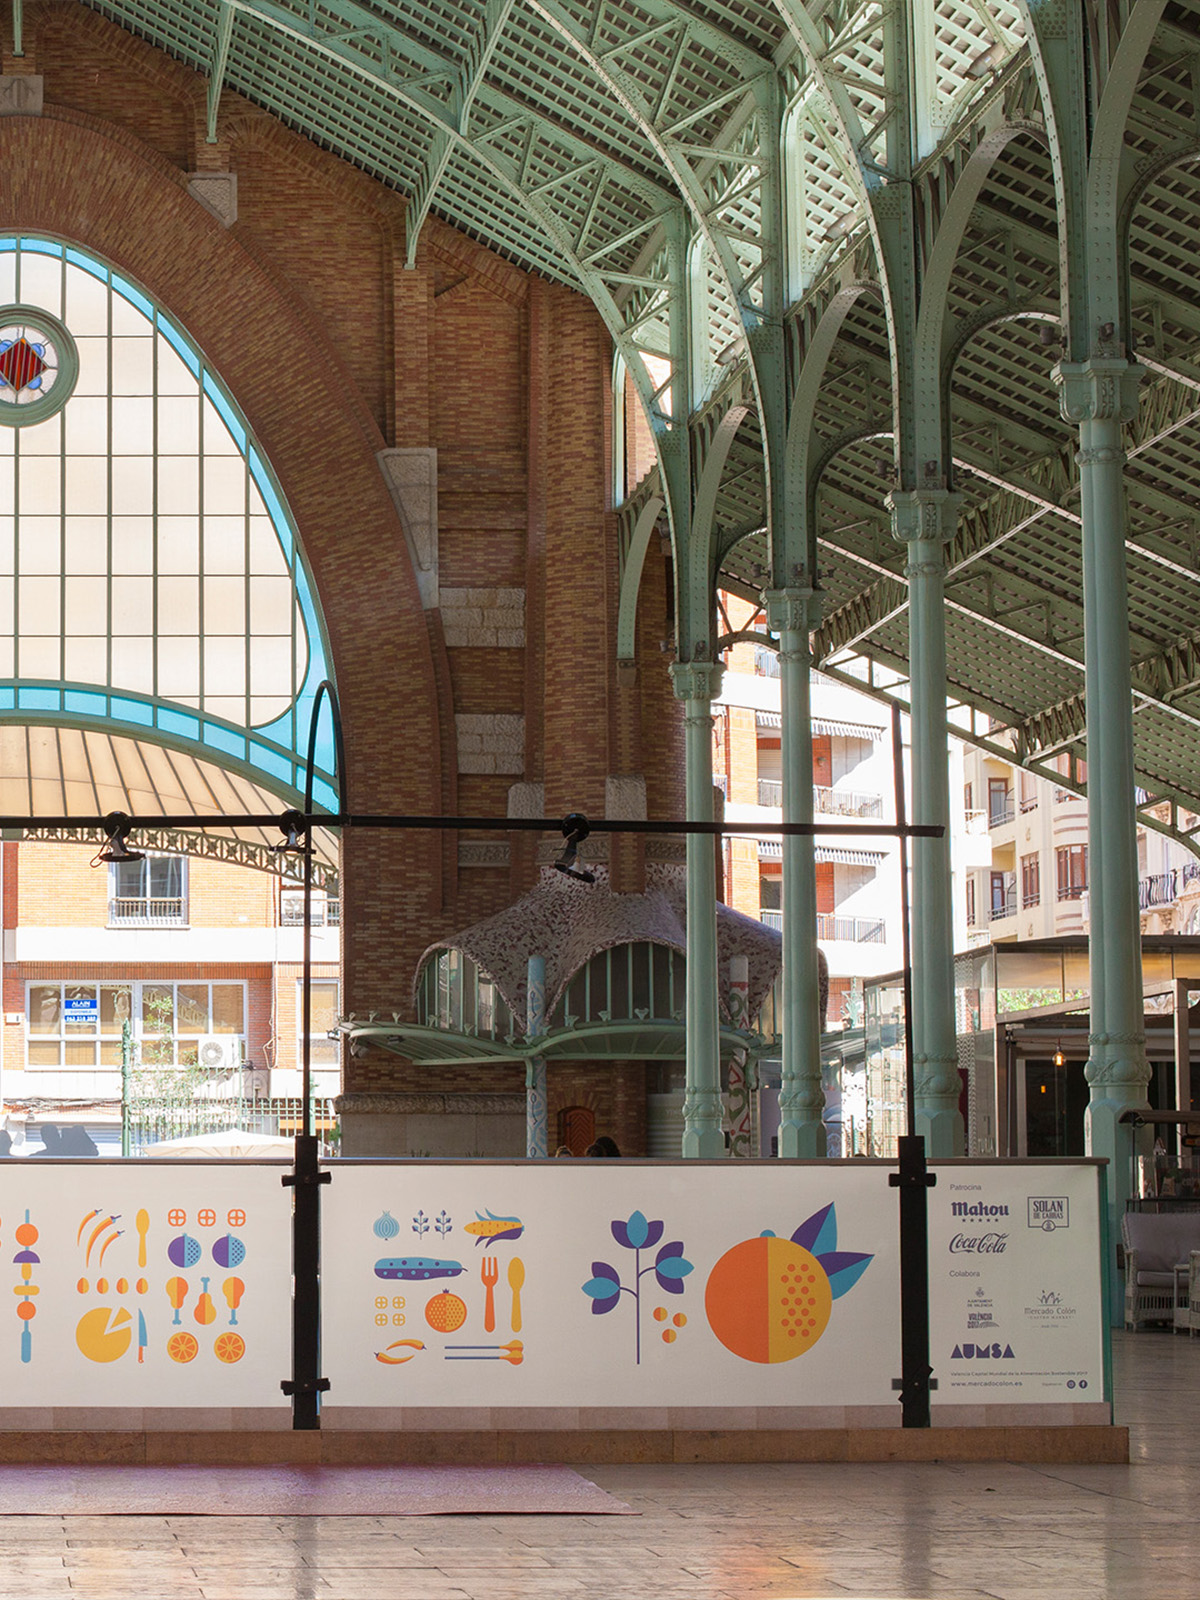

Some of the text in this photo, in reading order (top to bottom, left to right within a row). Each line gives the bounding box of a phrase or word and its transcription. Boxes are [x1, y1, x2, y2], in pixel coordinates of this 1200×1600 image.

[951, 1201, 1009, 1216] Mahou
[1033, 1200, 1063, 1212] SOLAN
[1057, 1307, 1076, 1315] Colón
[951, 1343, 1015, 1359] AUMSA
